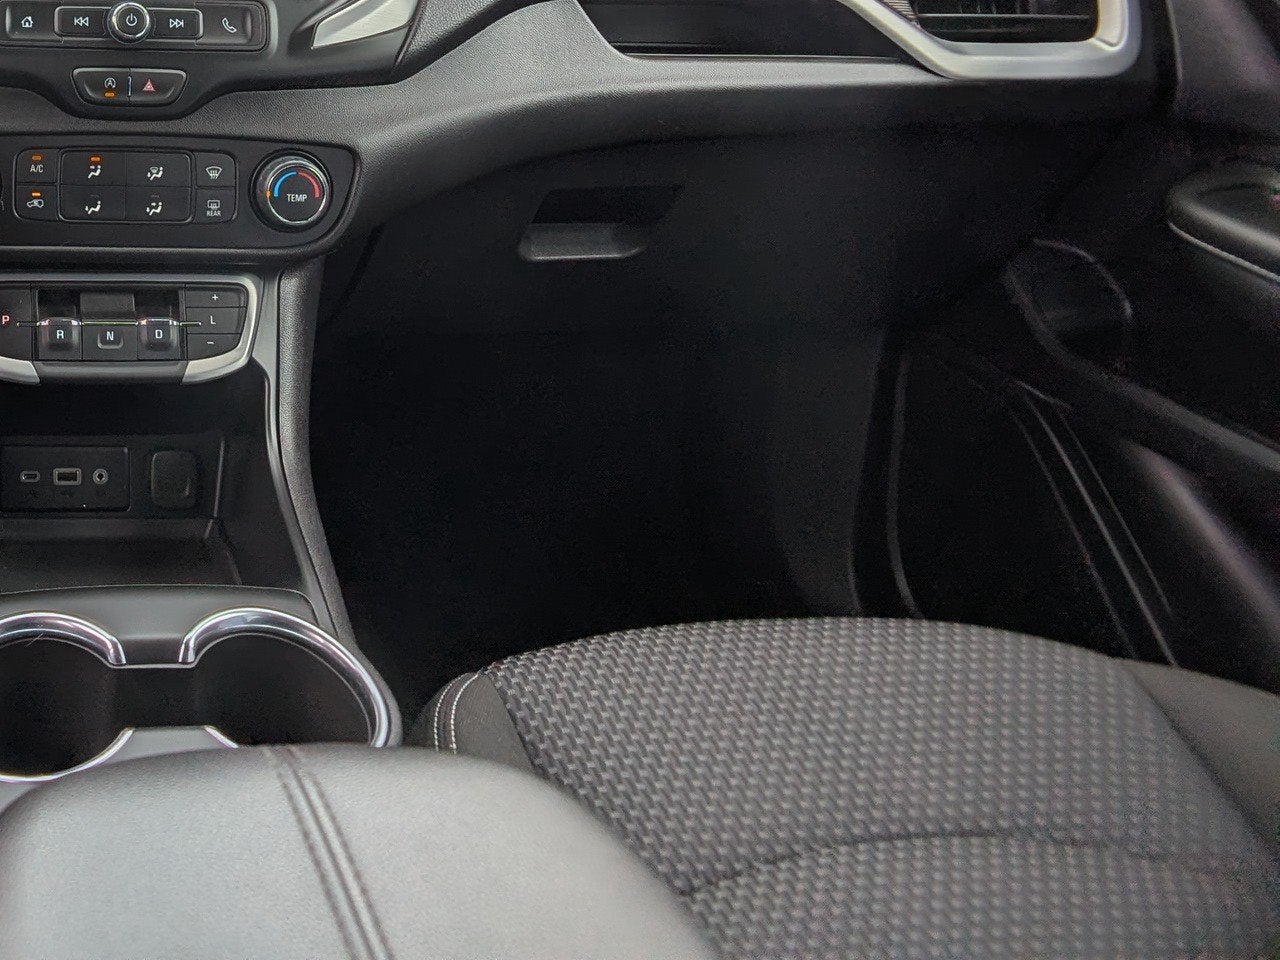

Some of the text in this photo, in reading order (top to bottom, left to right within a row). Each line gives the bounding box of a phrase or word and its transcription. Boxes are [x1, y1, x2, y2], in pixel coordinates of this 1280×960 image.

[30, 164, 44, 173] A/C
[286, 193, 308, 203] TEMP
[1, 315, 10, 325] P
[210, 315, 216, 325] L
[56, 329, 64, 339] R
[106, 331, 114, 341] N
[155, 329, 163, 339] D
